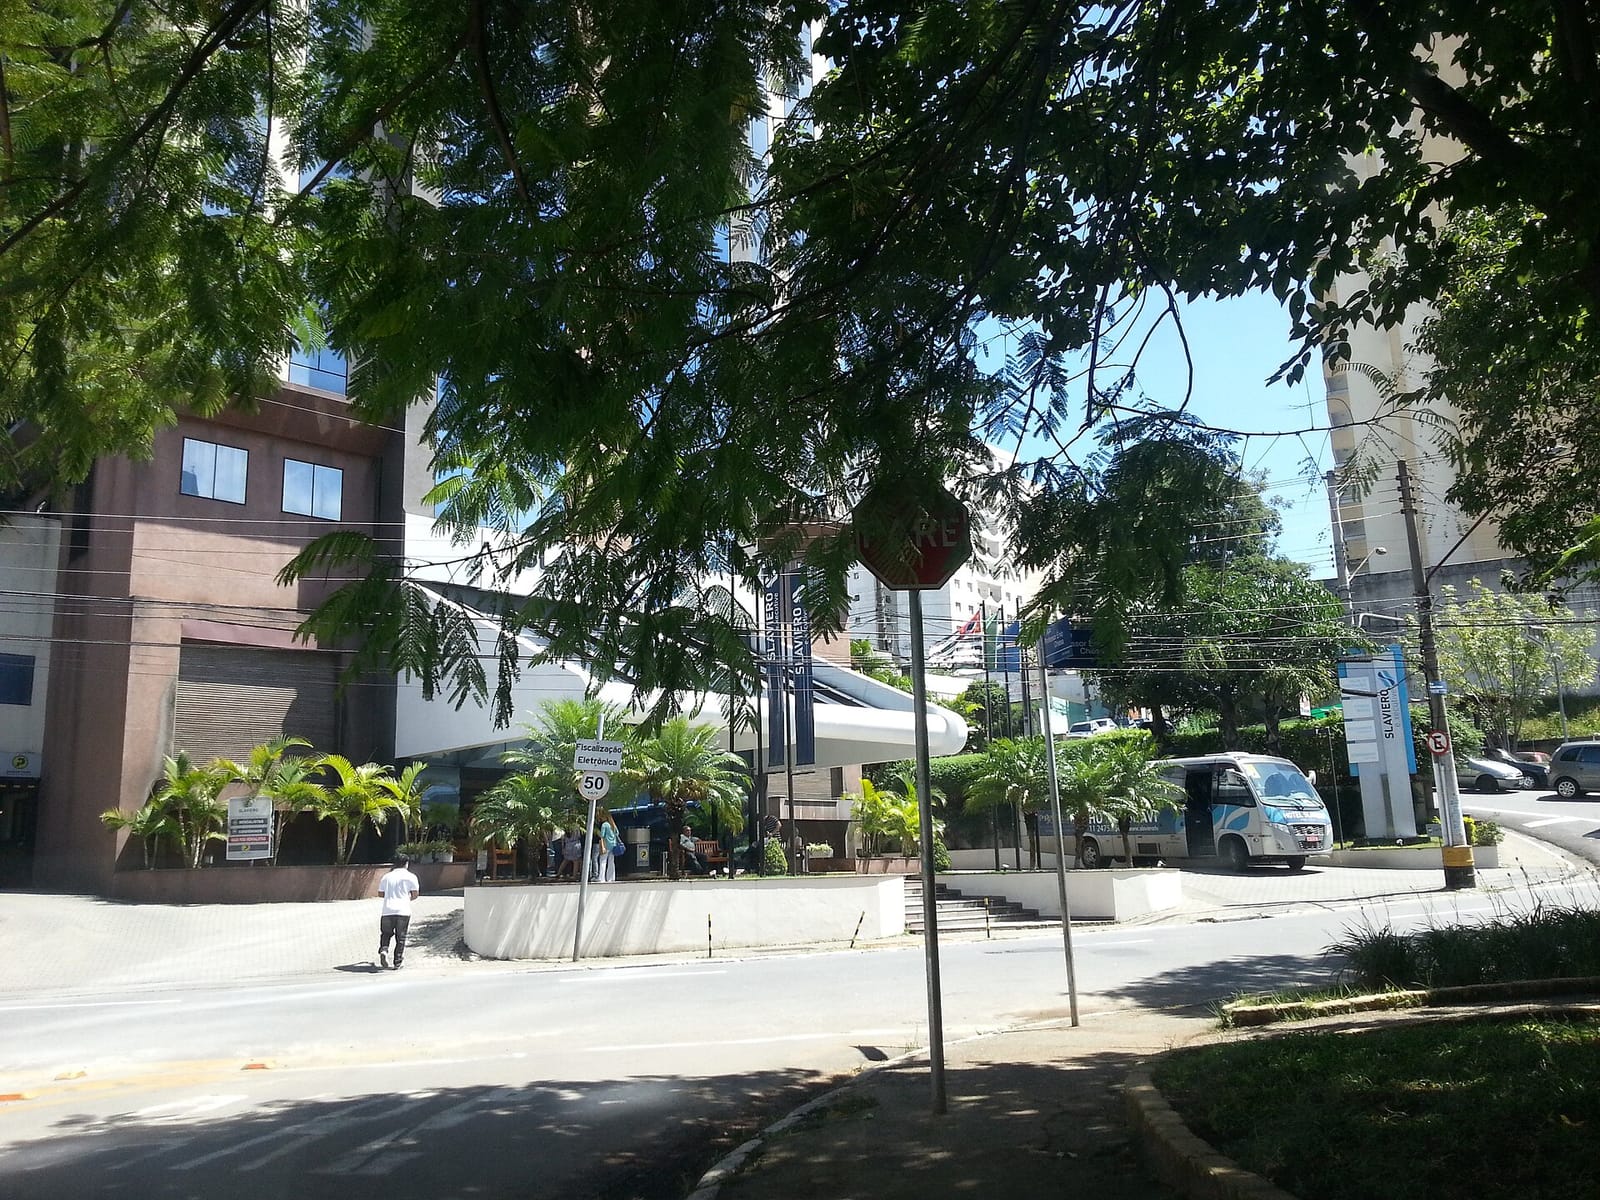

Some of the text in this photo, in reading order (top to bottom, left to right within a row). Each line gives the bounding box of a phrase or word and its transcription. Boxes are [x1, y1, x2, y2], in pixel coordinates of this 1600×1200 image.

[765, 592, 776, 661] SLAVIERO
[1380, 689, 1394, 739] SLAVIERO
[576, 743, 622, 755] Fiscalização
[584, 776, 604, 790] 50
